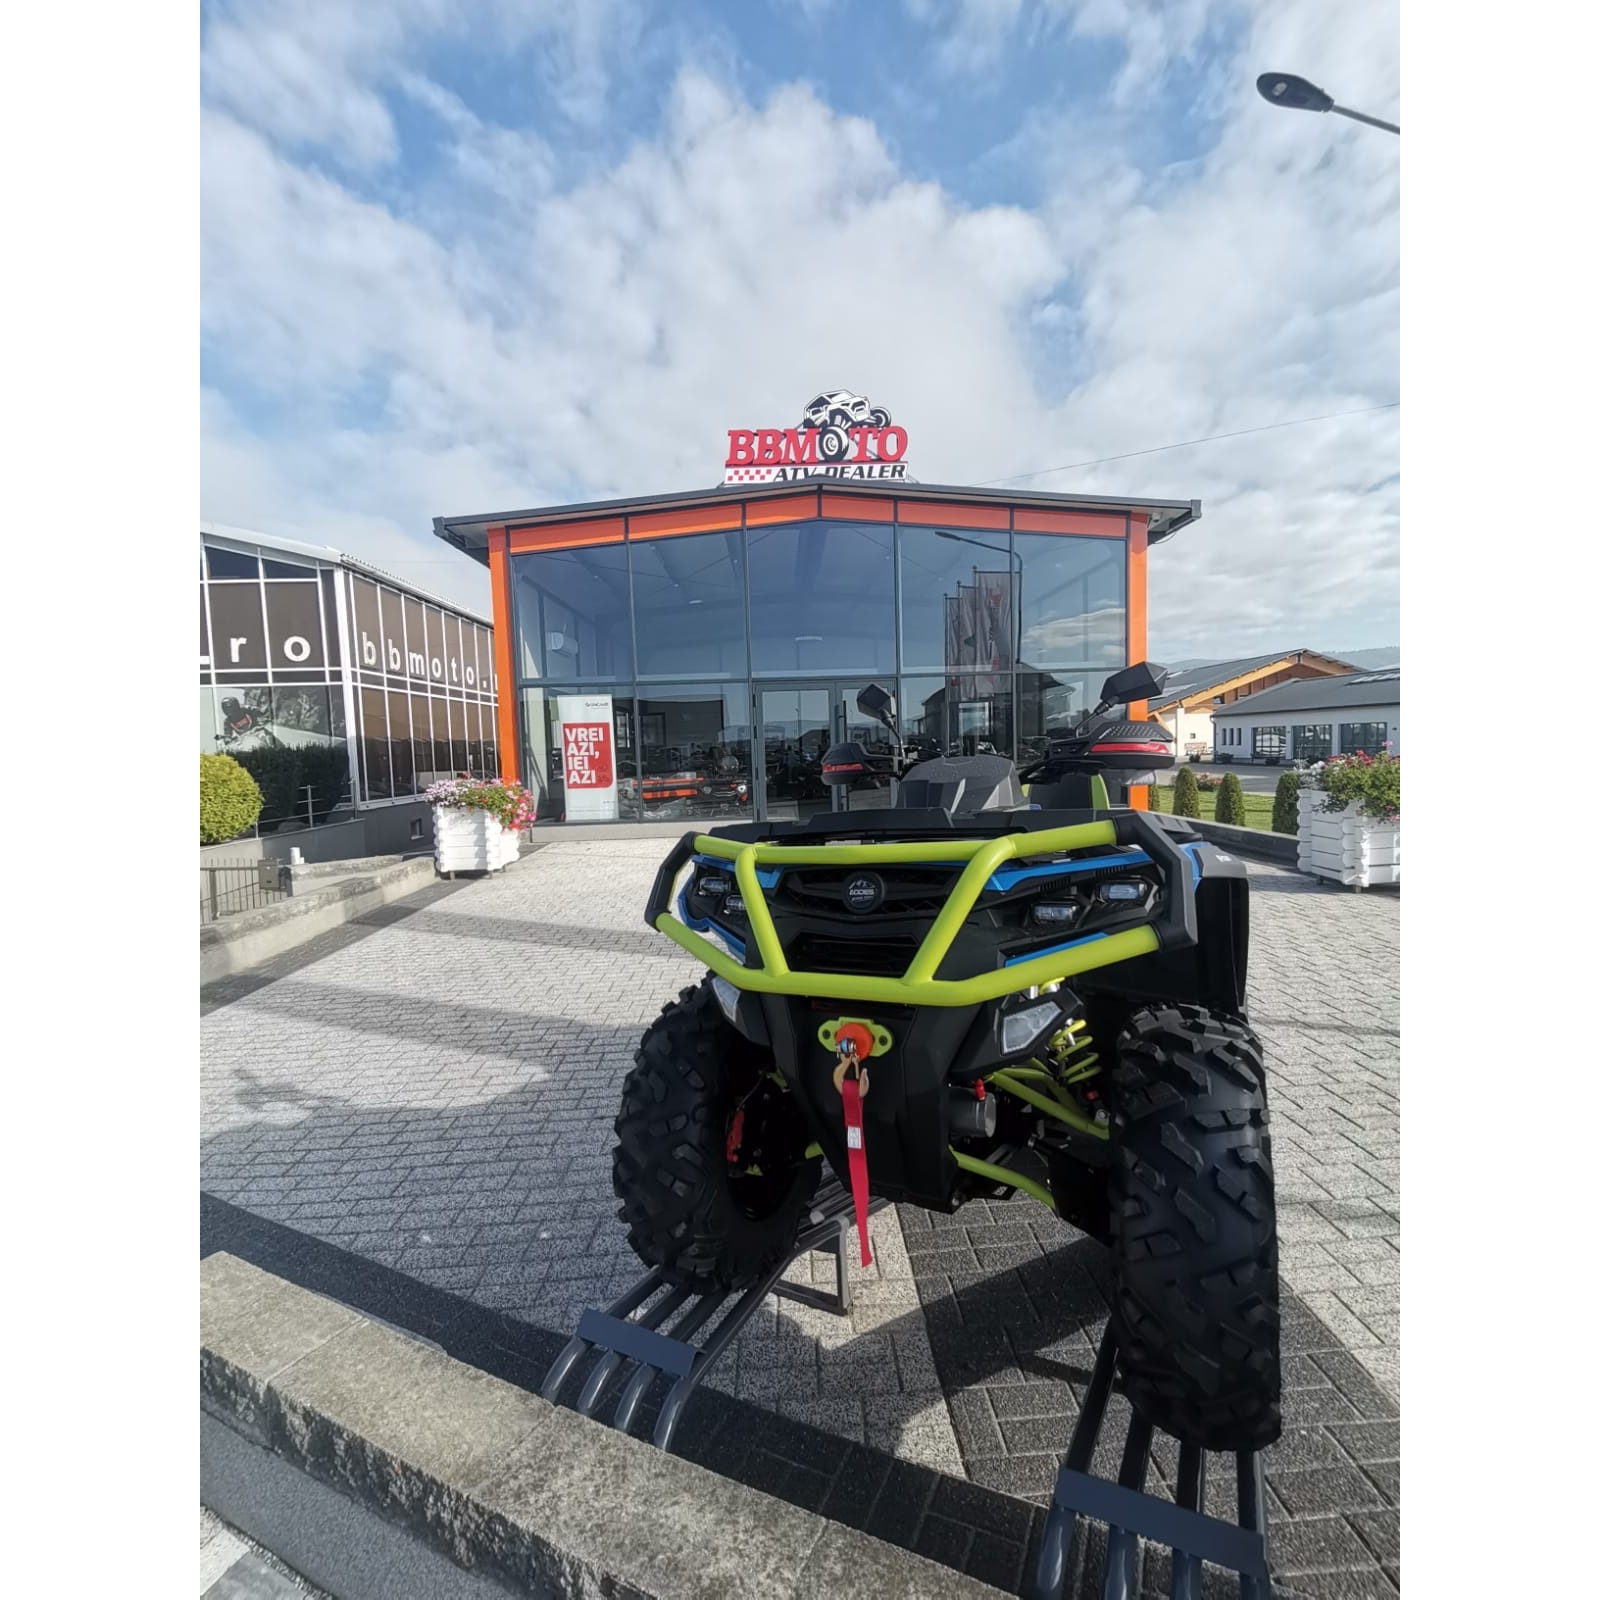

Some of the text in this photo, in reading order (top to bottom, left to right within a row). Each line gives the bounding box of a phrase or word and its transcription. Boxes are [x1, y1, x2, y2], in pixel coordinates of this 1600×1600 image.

[725, 426, 908, 465] BBMOTO
[774, 464, 906, 481] ATV DEALER
[565, 727, 604, 742] VREI
[567, 742, 599, 759] AZI,
[568, 756, 589, 771] IEI
[569, 770, 596, 785] AZI
